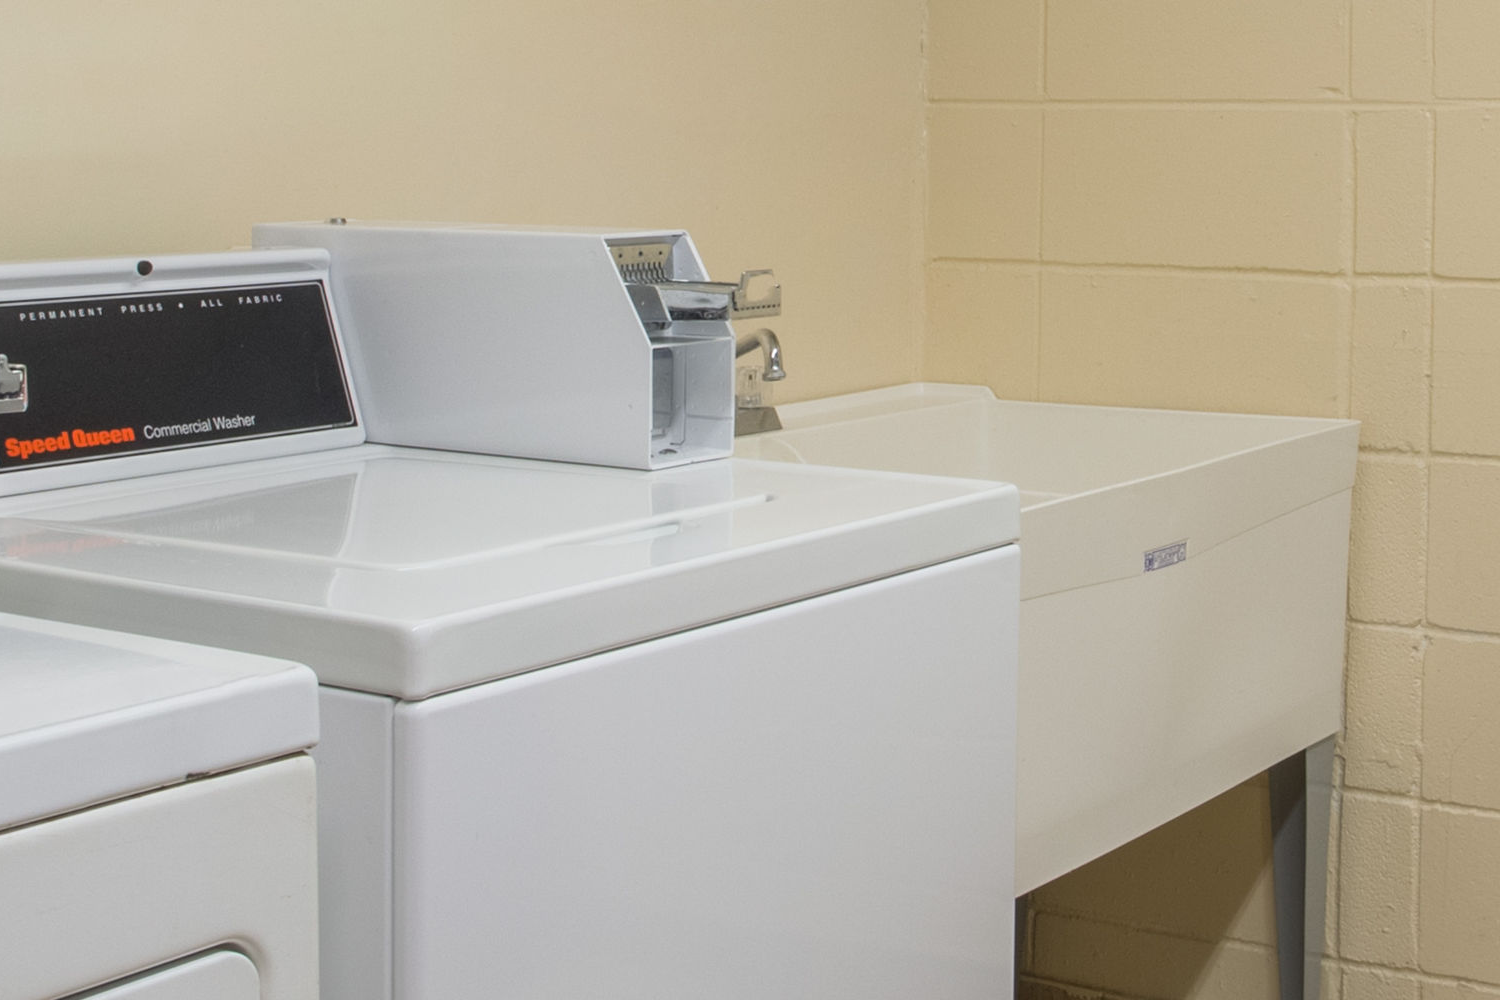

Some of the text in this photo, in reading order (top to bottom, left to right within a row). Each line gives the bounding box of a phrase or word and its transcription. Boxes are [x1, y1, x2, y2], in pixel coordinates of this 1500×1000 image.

[19, 293, 283, 321] PERMANENT PRESS ALL FABRIC
[4, 413, 256, 460] Speed Queen Commercial Washer
